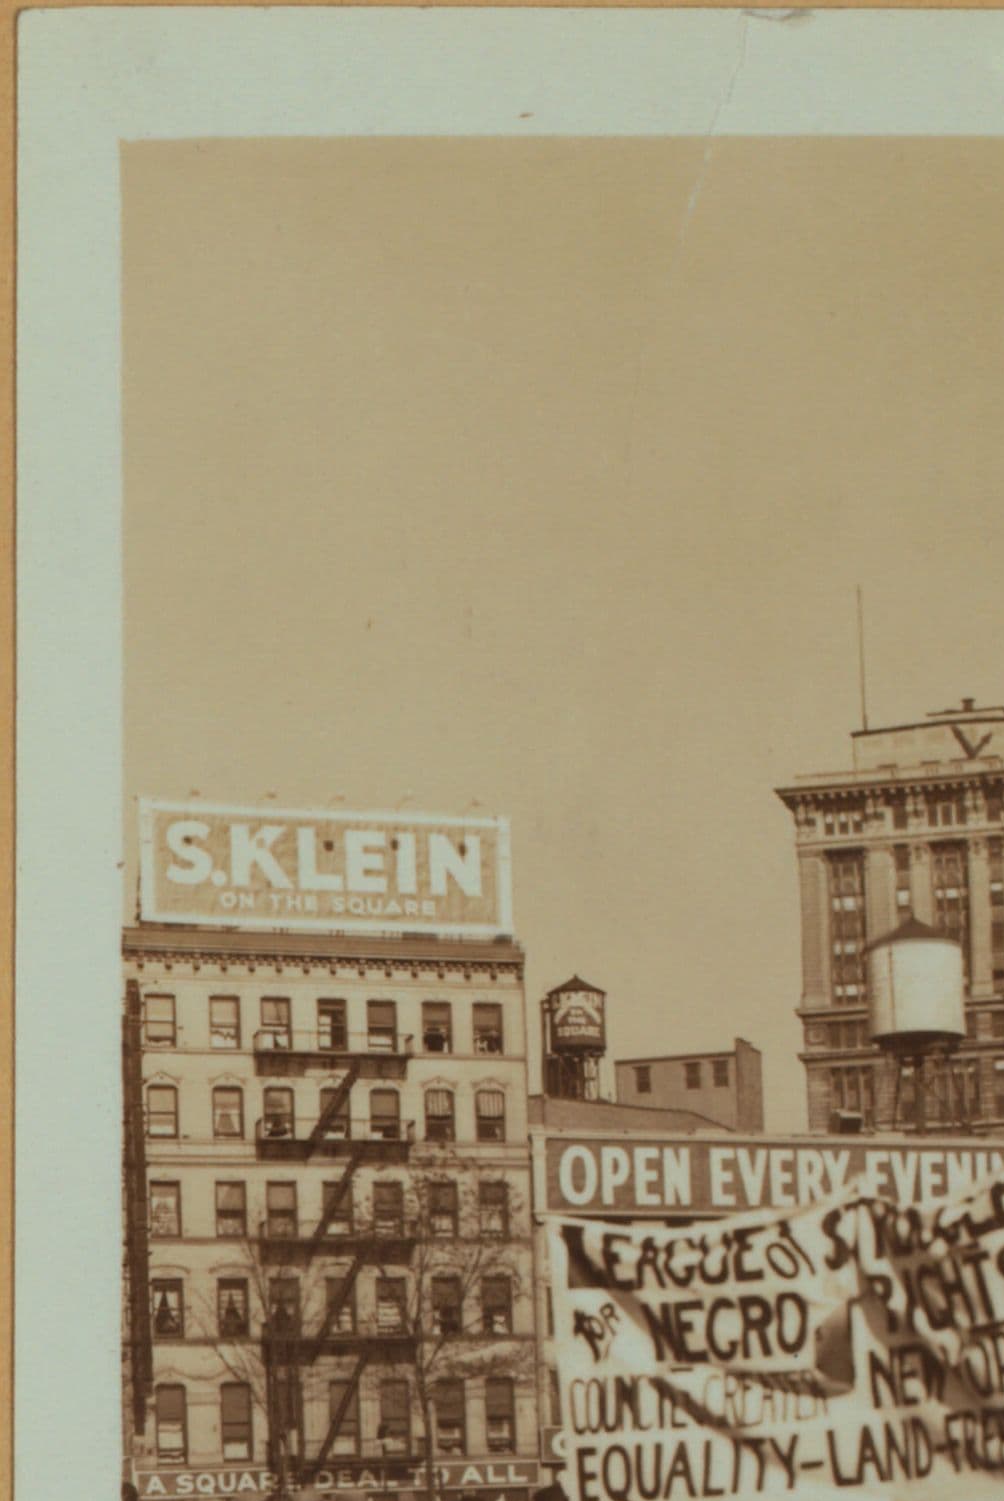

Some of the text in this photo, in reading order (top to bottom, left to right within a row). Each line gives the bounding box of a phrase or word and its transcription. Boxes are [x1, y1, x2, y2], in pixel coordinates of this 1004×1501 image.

[219, 891, 437, 917] ON THE SQUARE
[558, 1144, 692, 1206] OPEN
[709, 1147, 852, 1207] EVERY
[641, 1292, 808, 1362] NEGRO
[146, 1475, 167, 1495] A
[460, 1464, 528, 1486] ALL
